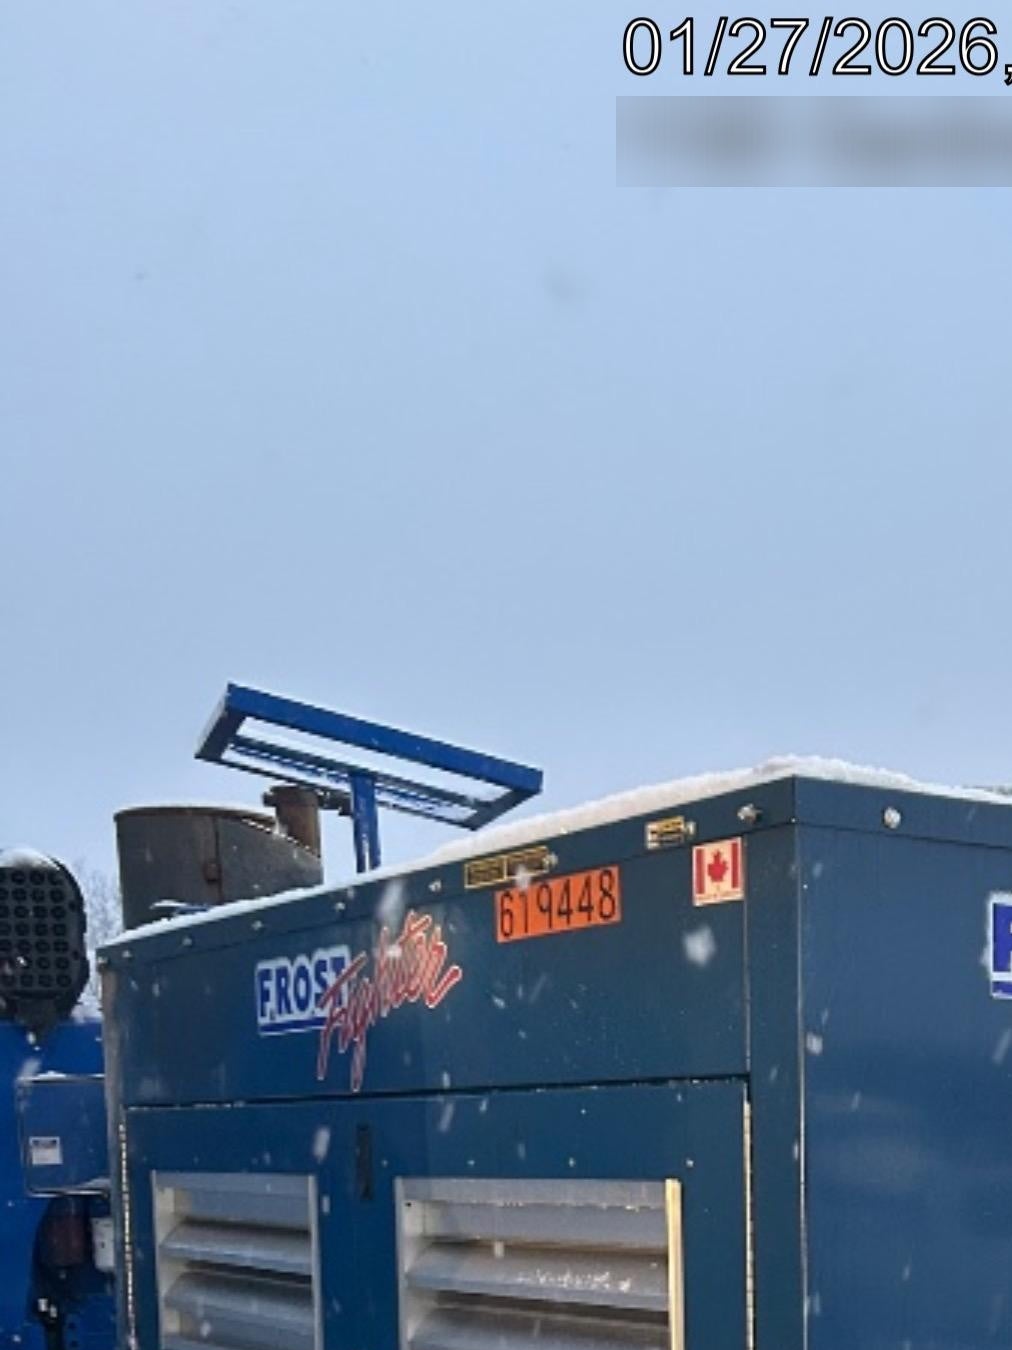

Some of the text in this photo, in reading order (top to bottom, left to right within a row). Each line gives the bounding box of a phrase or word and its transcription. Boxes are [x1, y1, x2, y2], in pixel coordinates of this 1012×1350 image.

[499, 869, 618, 939] 619448
[256, 909, 463, 1093] FROST Fighter
